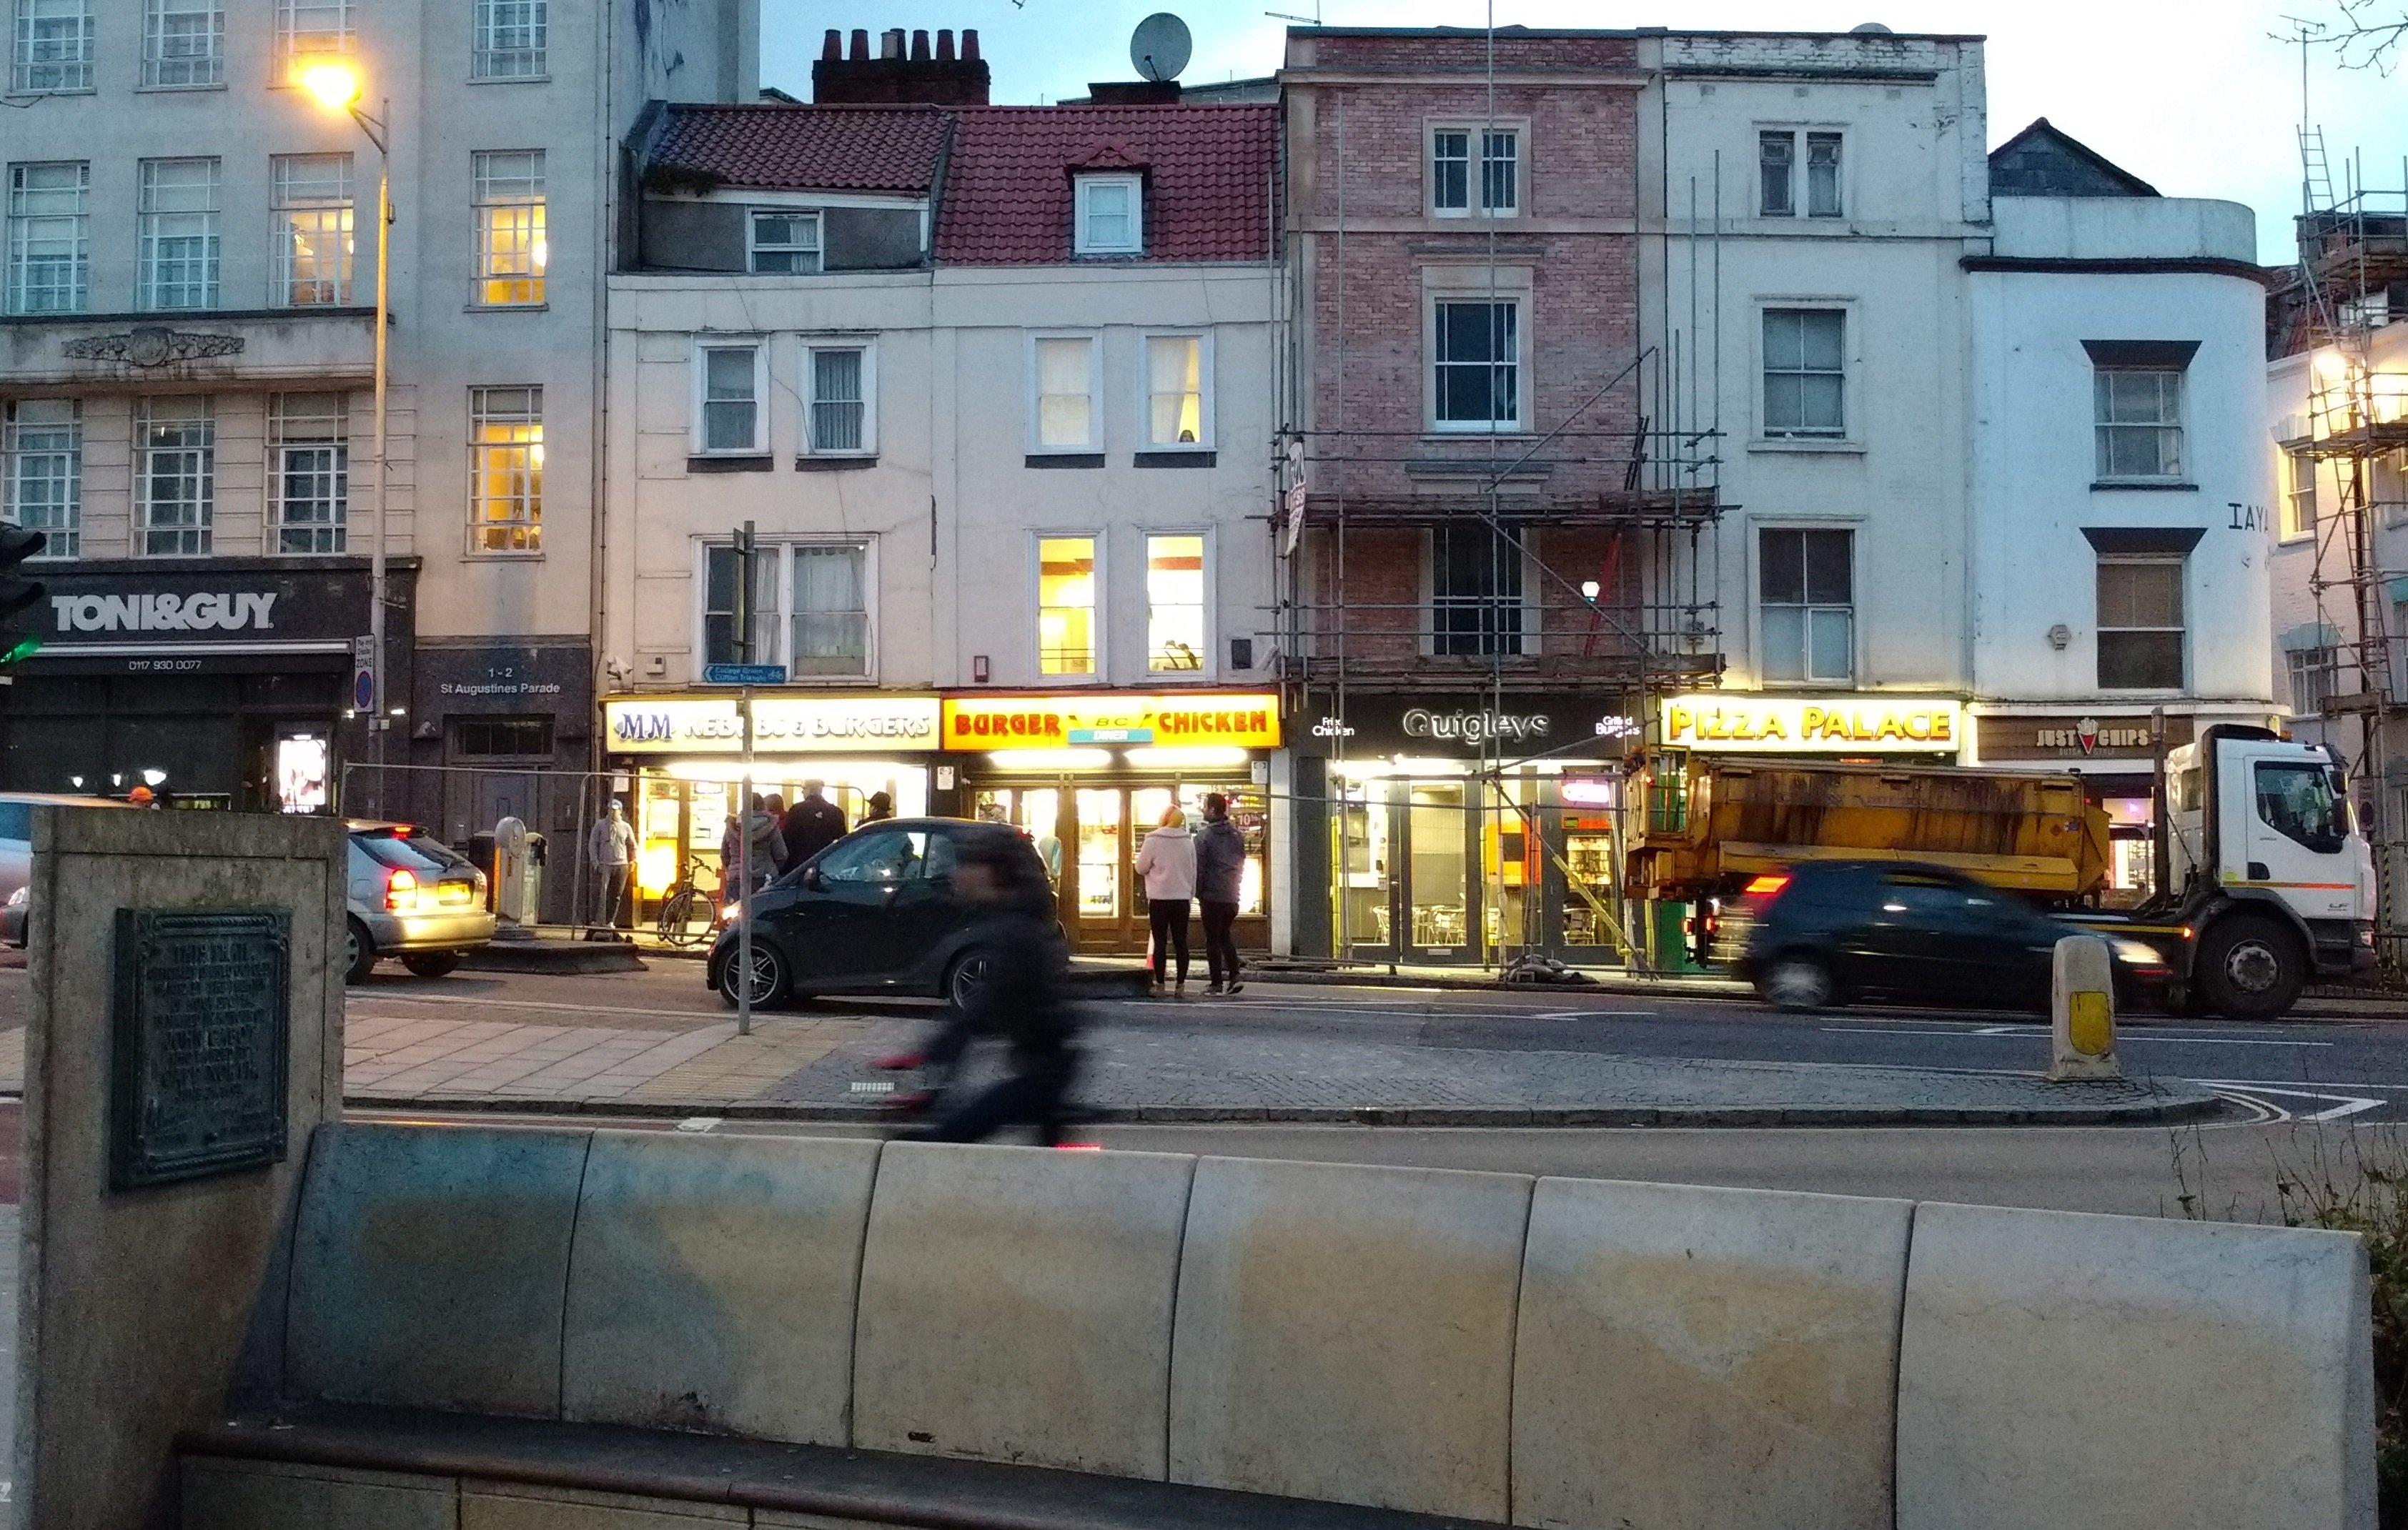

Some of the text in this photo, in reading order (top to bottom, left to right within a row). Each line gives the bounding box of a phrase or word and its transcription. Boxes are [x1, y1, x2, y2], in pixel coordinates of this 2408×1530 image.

[51, 592, 278, 632] TONI&GUY
[129, 660, 202, 670] 0117 930 0077
[488, 667, 495, 678] 1
[505, 667, 513, 677] 2
[440, 683, 560, 696] St Augustines Parade
[620, 714, 673, 740] MM
[811, 715, 930, 739] BURGERS
[955, 714, 1062, 737] BURGER
[1159, 710, 1267, 734] CHICKEN
[1403, 707, 1550, 745] Quigleys
[1670, 704, 1951, 740] PIZZA PALACE
[2037, 729, 2149, 747] JUST CHIPS
